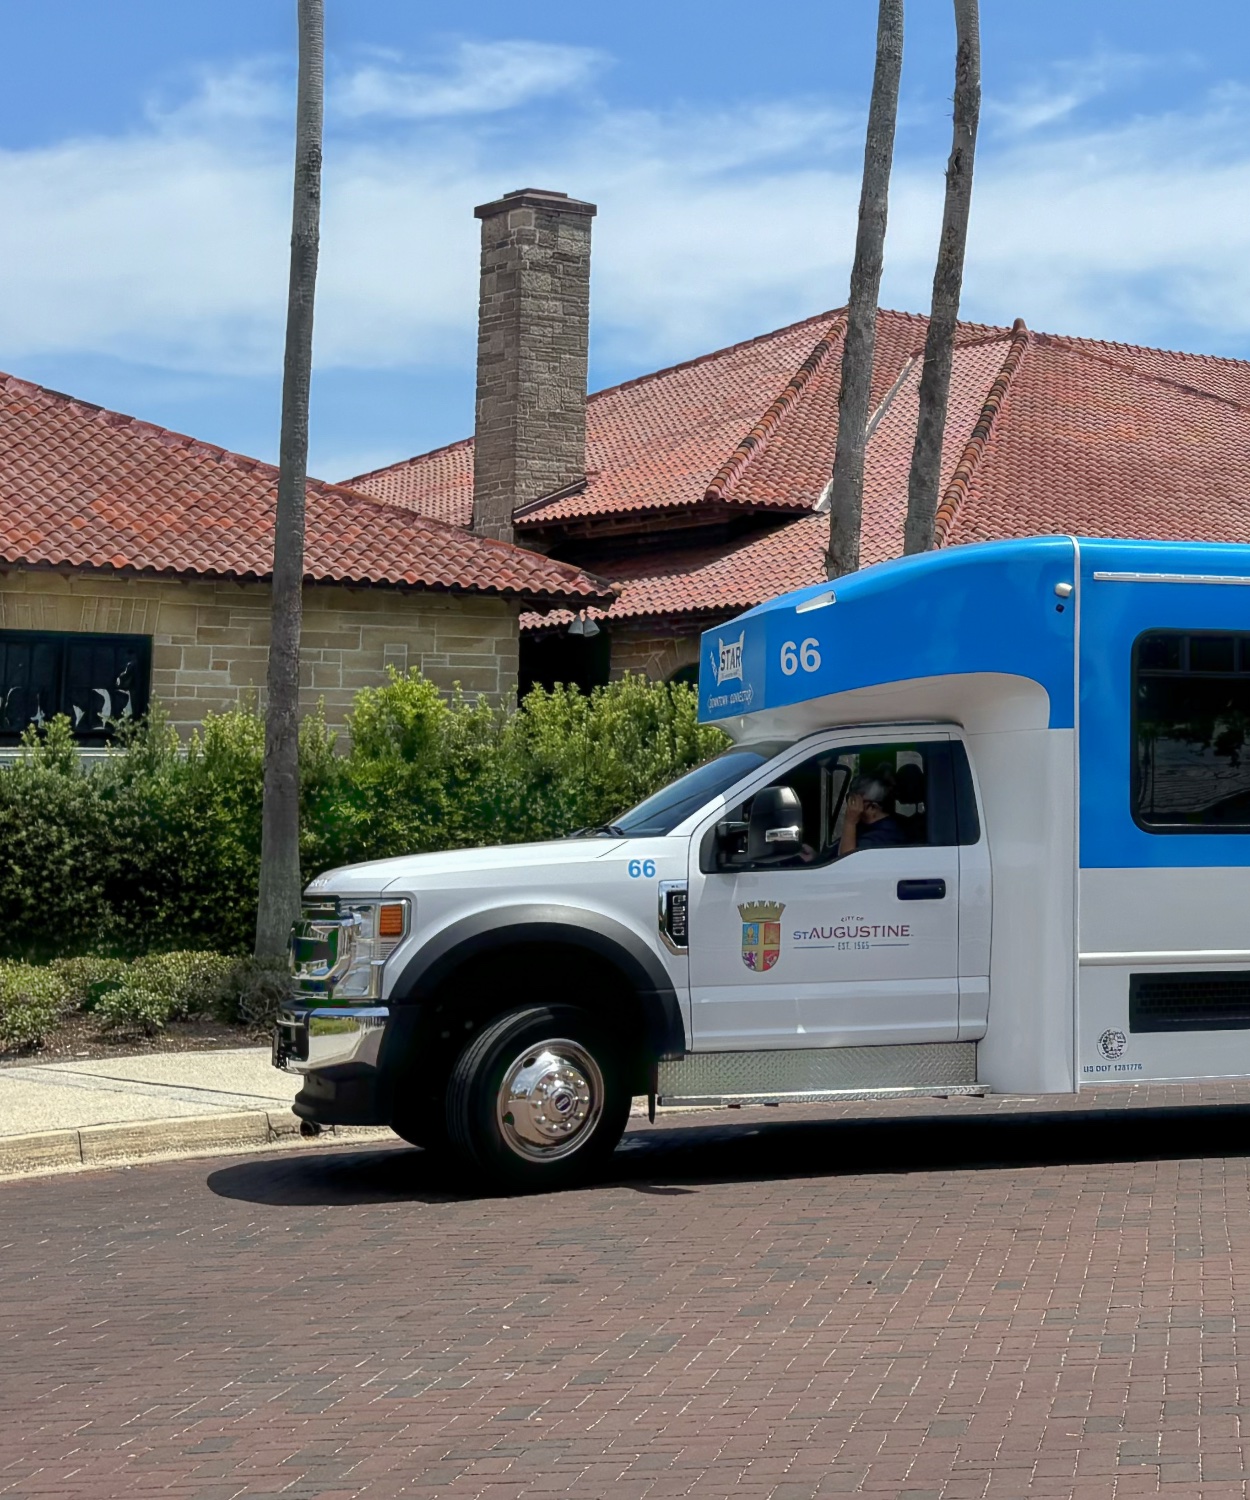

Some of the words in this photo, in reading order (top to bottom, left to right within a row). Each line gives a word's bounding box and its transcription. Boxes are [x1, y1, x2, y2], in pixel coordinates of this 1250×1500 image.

[720, 647, 741, 671] STAR
[780, 637, 822, 676] 66
[628, 859, 656, 878] 66
